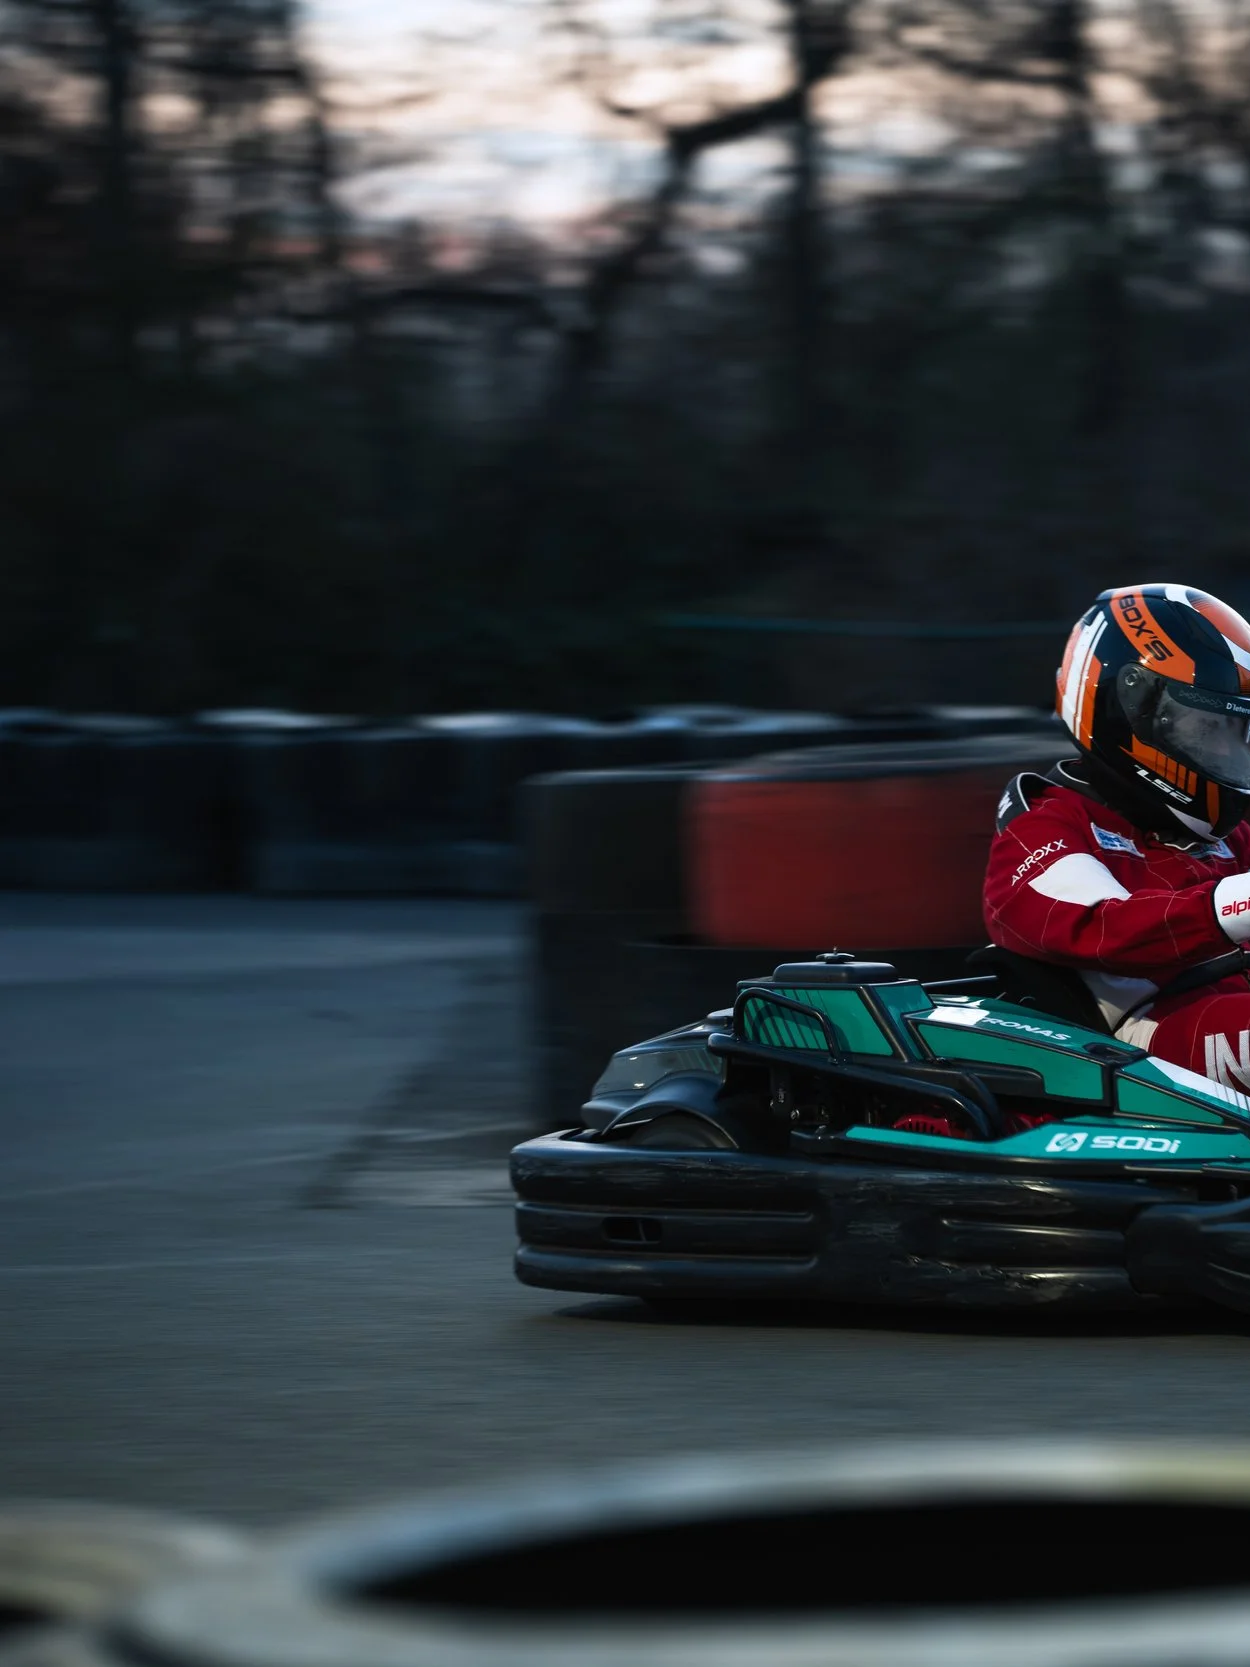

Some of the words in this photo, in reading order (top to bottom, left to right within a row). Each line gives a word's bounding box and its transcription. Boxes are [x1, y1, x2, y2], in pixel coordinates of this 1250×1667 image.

[1118, 594, 1175, 662] BOX'S
[1136, 767, 1193, 805] LS2
[1011, 838, 1069, 887] ARROXX
[982, 1017, 1072, 1041] RONAS
